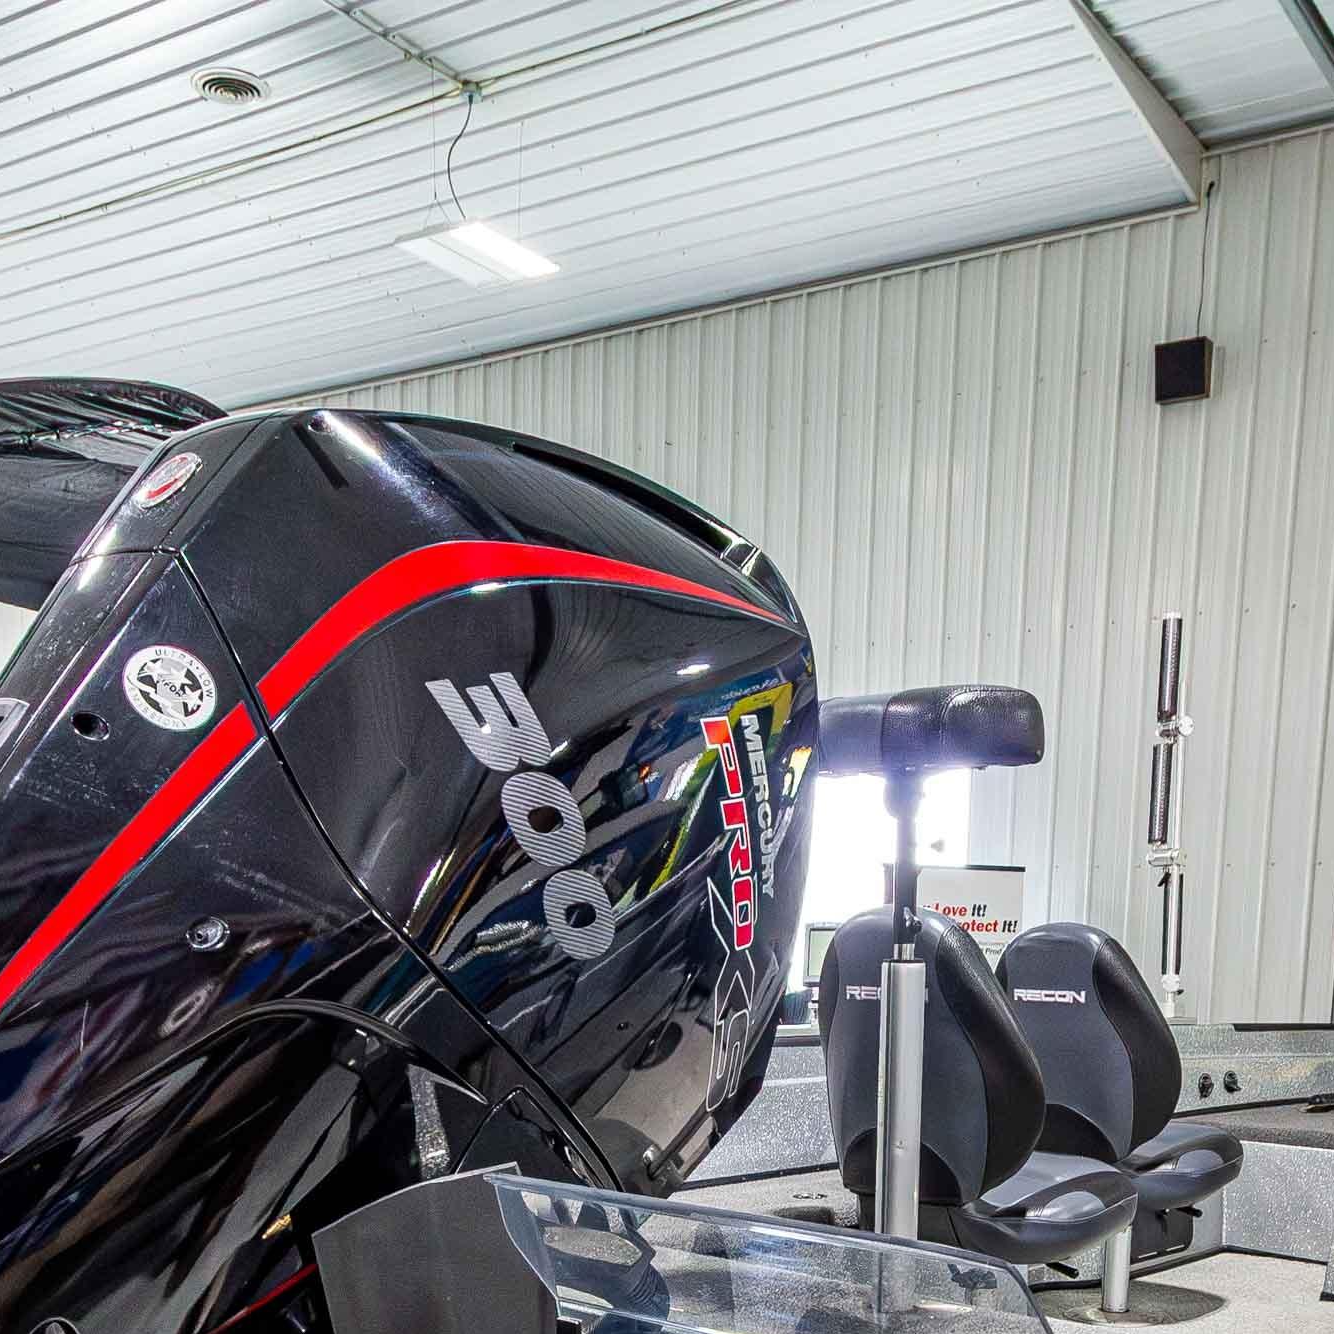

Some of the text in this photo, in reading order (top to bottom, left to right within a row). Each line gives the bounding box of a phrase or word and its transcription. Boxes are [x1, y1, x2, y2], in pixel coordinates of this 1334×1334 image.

[424, 671, 616, 960] 300
[700, 715, 754, 951] PRO
[740, 713, 780, 898] MERCURY
[957, 919, 1019, 933] otect It!
[971, 903, 987, 917] It!
[1013, 988, 1087, 1005] RECON
